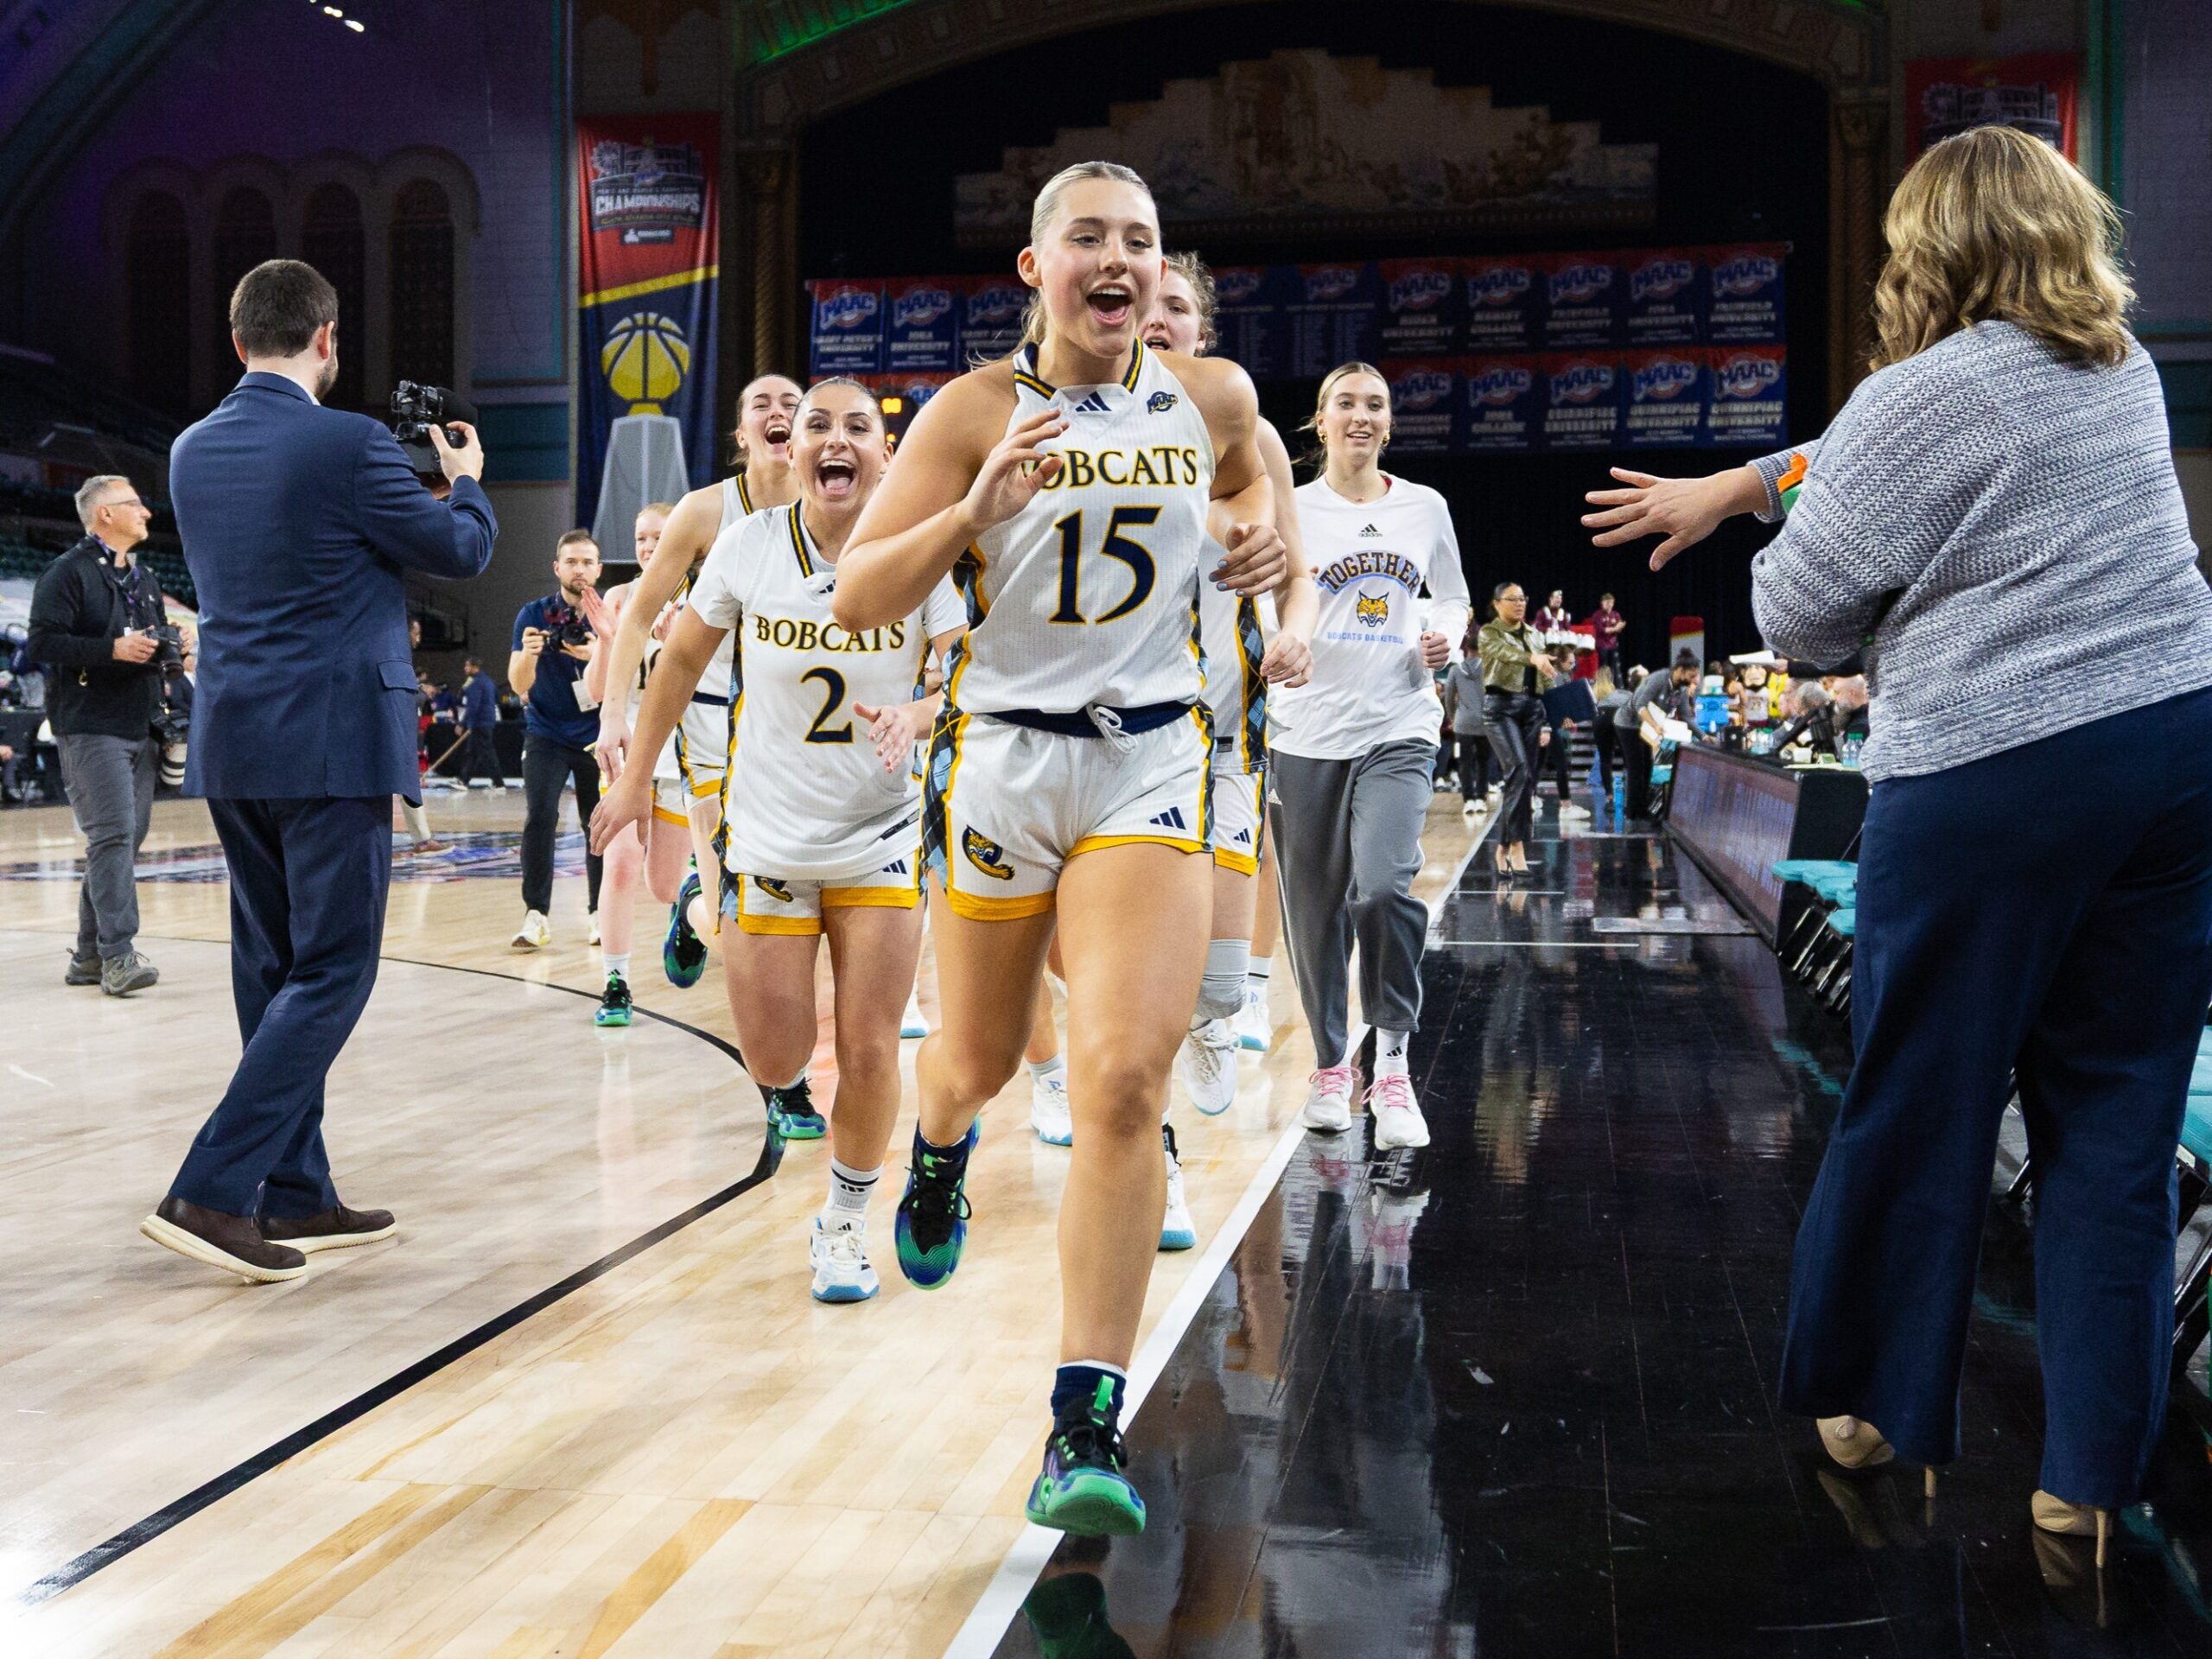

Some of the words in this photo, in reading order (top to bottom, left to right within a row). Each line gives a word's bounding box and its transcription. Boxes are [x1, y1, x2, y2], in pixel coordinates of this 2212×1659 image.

[595, 193, 700, 215] CHAMPIONSHIPS
[1389, 272, 1452, 313] MAAC
[1467, 268, 1532, 308] MAAC
[1549, 264, 1613, 304] MAAC
[1631, 260, 1694, 302] MAAC
[1713, 257, 1778, 298] MAAC
[821, 291, 878, 329] MAAC
[893, 289, 951, 328] MAAC
[891, 341, 950, 352] UNIVERSITY
[1394, 372, 1452, 411] MAAC
[1468, 369, 1532, 407] MAAC
[1551, 365, 1615, 404] MAAC
[1634, 360, 1697, 402] MAAC
[1714, 359, 1781, 400] MAAC
[1147, 393, 1179, 415] MAAC
[1626, 416, 1700, 429] UNIVERSITY
[1707, 414, 1783, 429] UNIVERSITY
[1023, 446, 1198, 490] OBCATS
[1048, 504, 1163, 626] 15
[1318, 551, 1421, 595] TOGETHER
[1327, 632, 1363, 641] BOBCATS
[799, 666, 855, 744] 2
